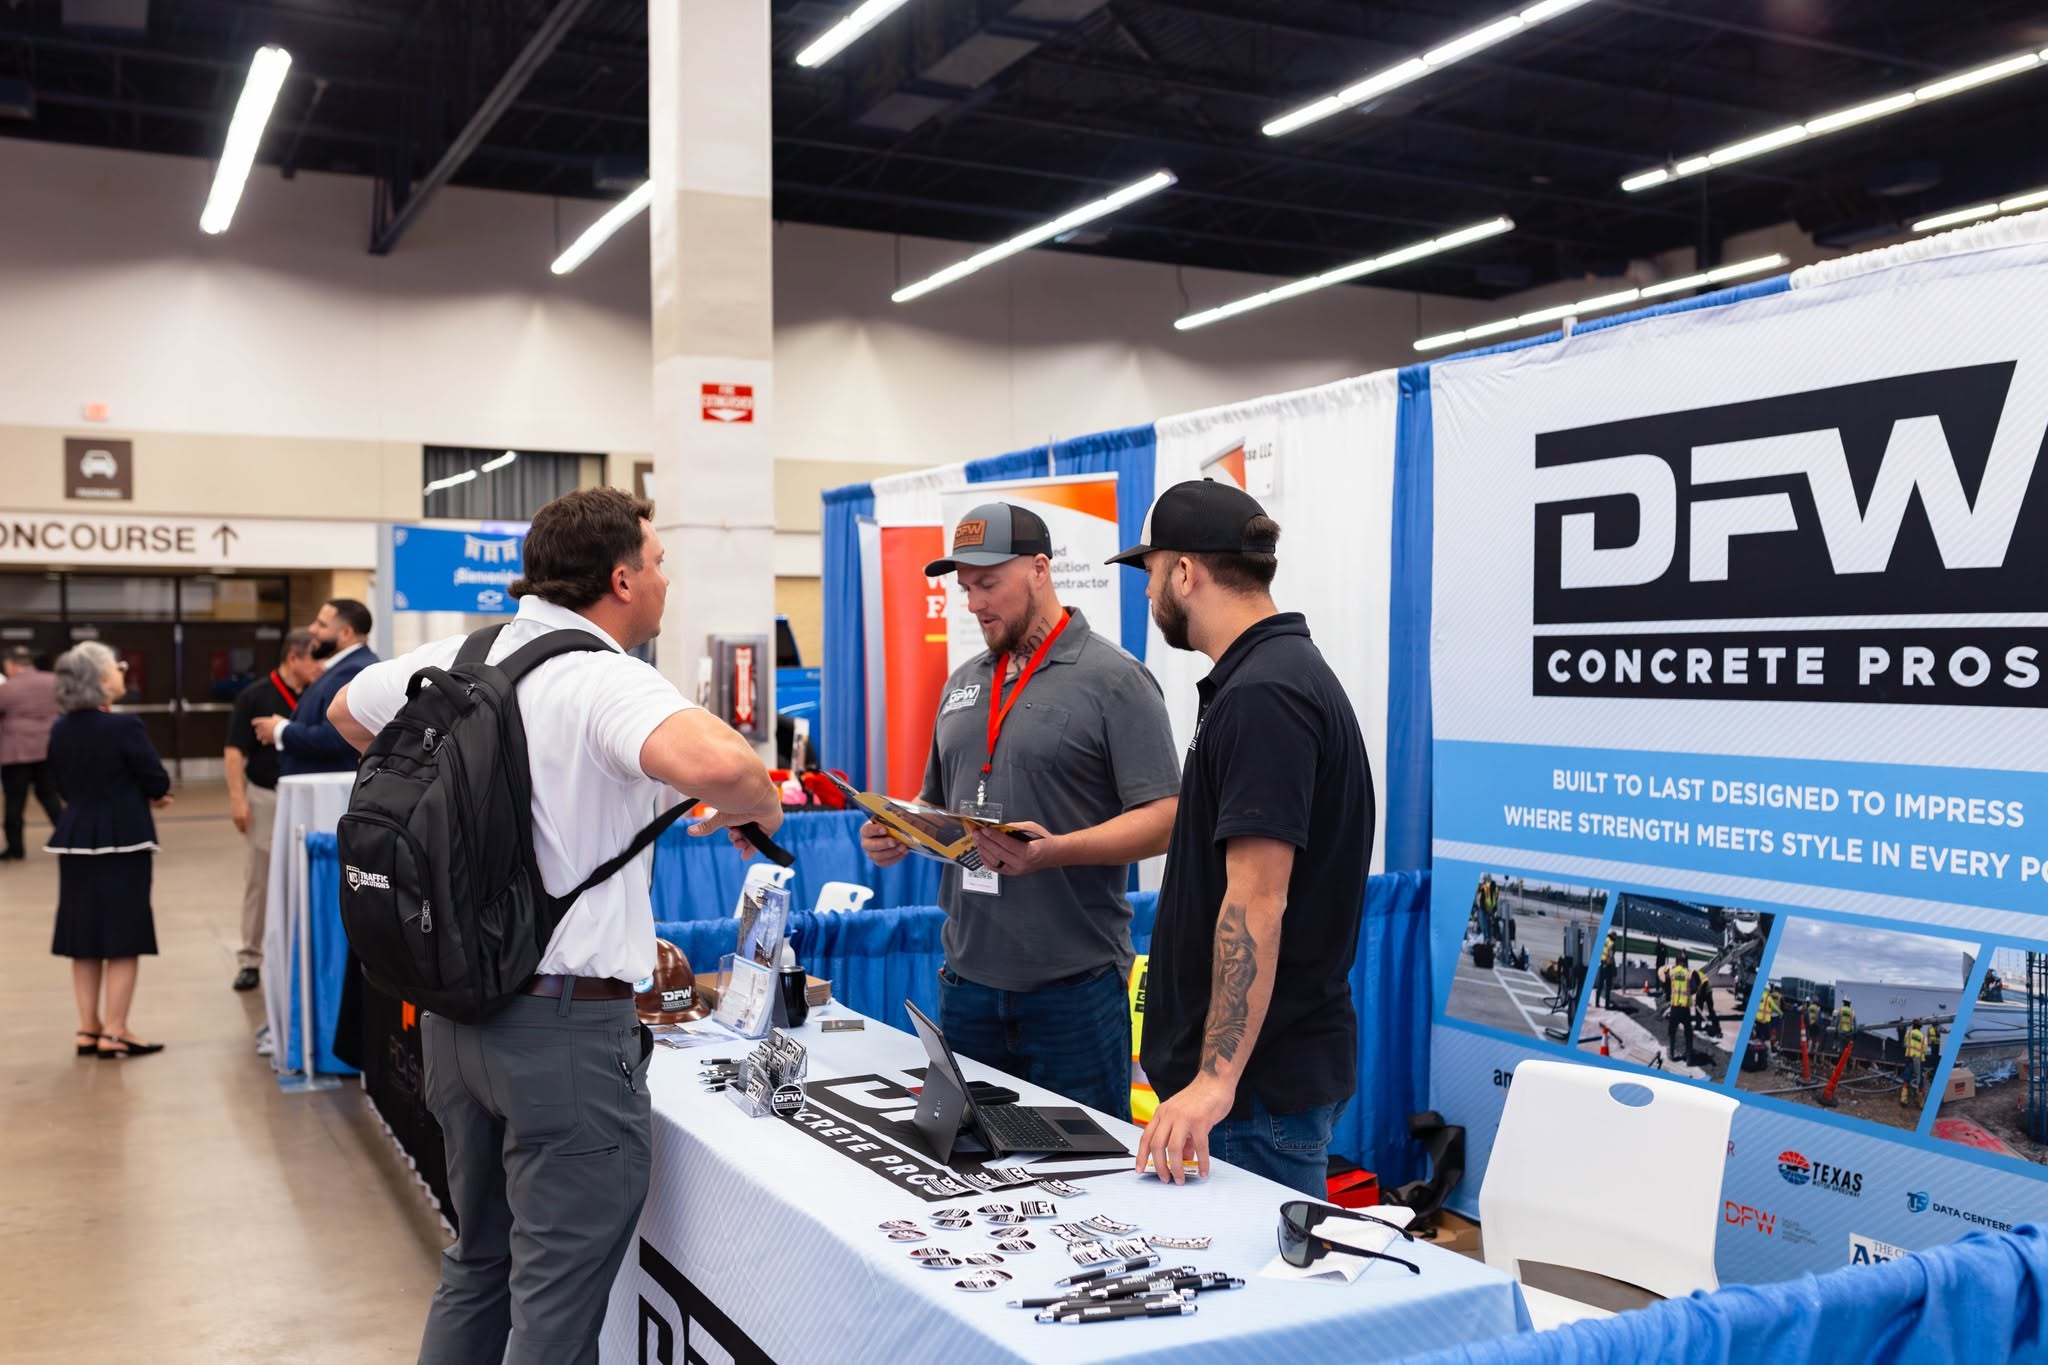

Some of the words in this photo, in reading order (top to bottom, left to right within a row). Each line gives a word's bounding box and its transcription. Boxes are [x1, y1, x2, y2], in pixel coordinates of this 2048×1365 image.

[1535, 402, 2048, 590] DFW
[1547, 647, 1825, 685] CONCRETE
[1858, 645, 2041, 689] PROS
[1552, 768, 1608, 794] BUILT
[1613, 772, 1643, 797] TO
[1649, 775, 1705, 802] LAST
[1711, 780, 1840, 813] DESIGNED
[1848, 788, 1886, 816] TO
[1895, 792, 2025, 828] IMPRESS
[1503, 804, 1573, 833] WHERE
[1578, 812, 1689, 845] STRENGTH
[1697, 823, 1775, 854] MEETS
[1781, 831, 1863, 864] STYLE
[1872, 840, 1901, 868] IN
[1910, 843, 2011, 880] EVERY
[2020, 855, 2048, 885] P
[359, 871, 389, 883] TRAFFIC
[661, 985, 692, 1002] DFW
[774, 1092, 803, 1103] DFW
[1812, 1161, 1863, 1193] TEXAS
[1725, 1200, 1776, 1236] DFW
[1932, 1202, 1961, 1219] DATA
[1962, 1211, 2013, 1233] CENTERS
[1873, 1241, 1894, 1257] THE
